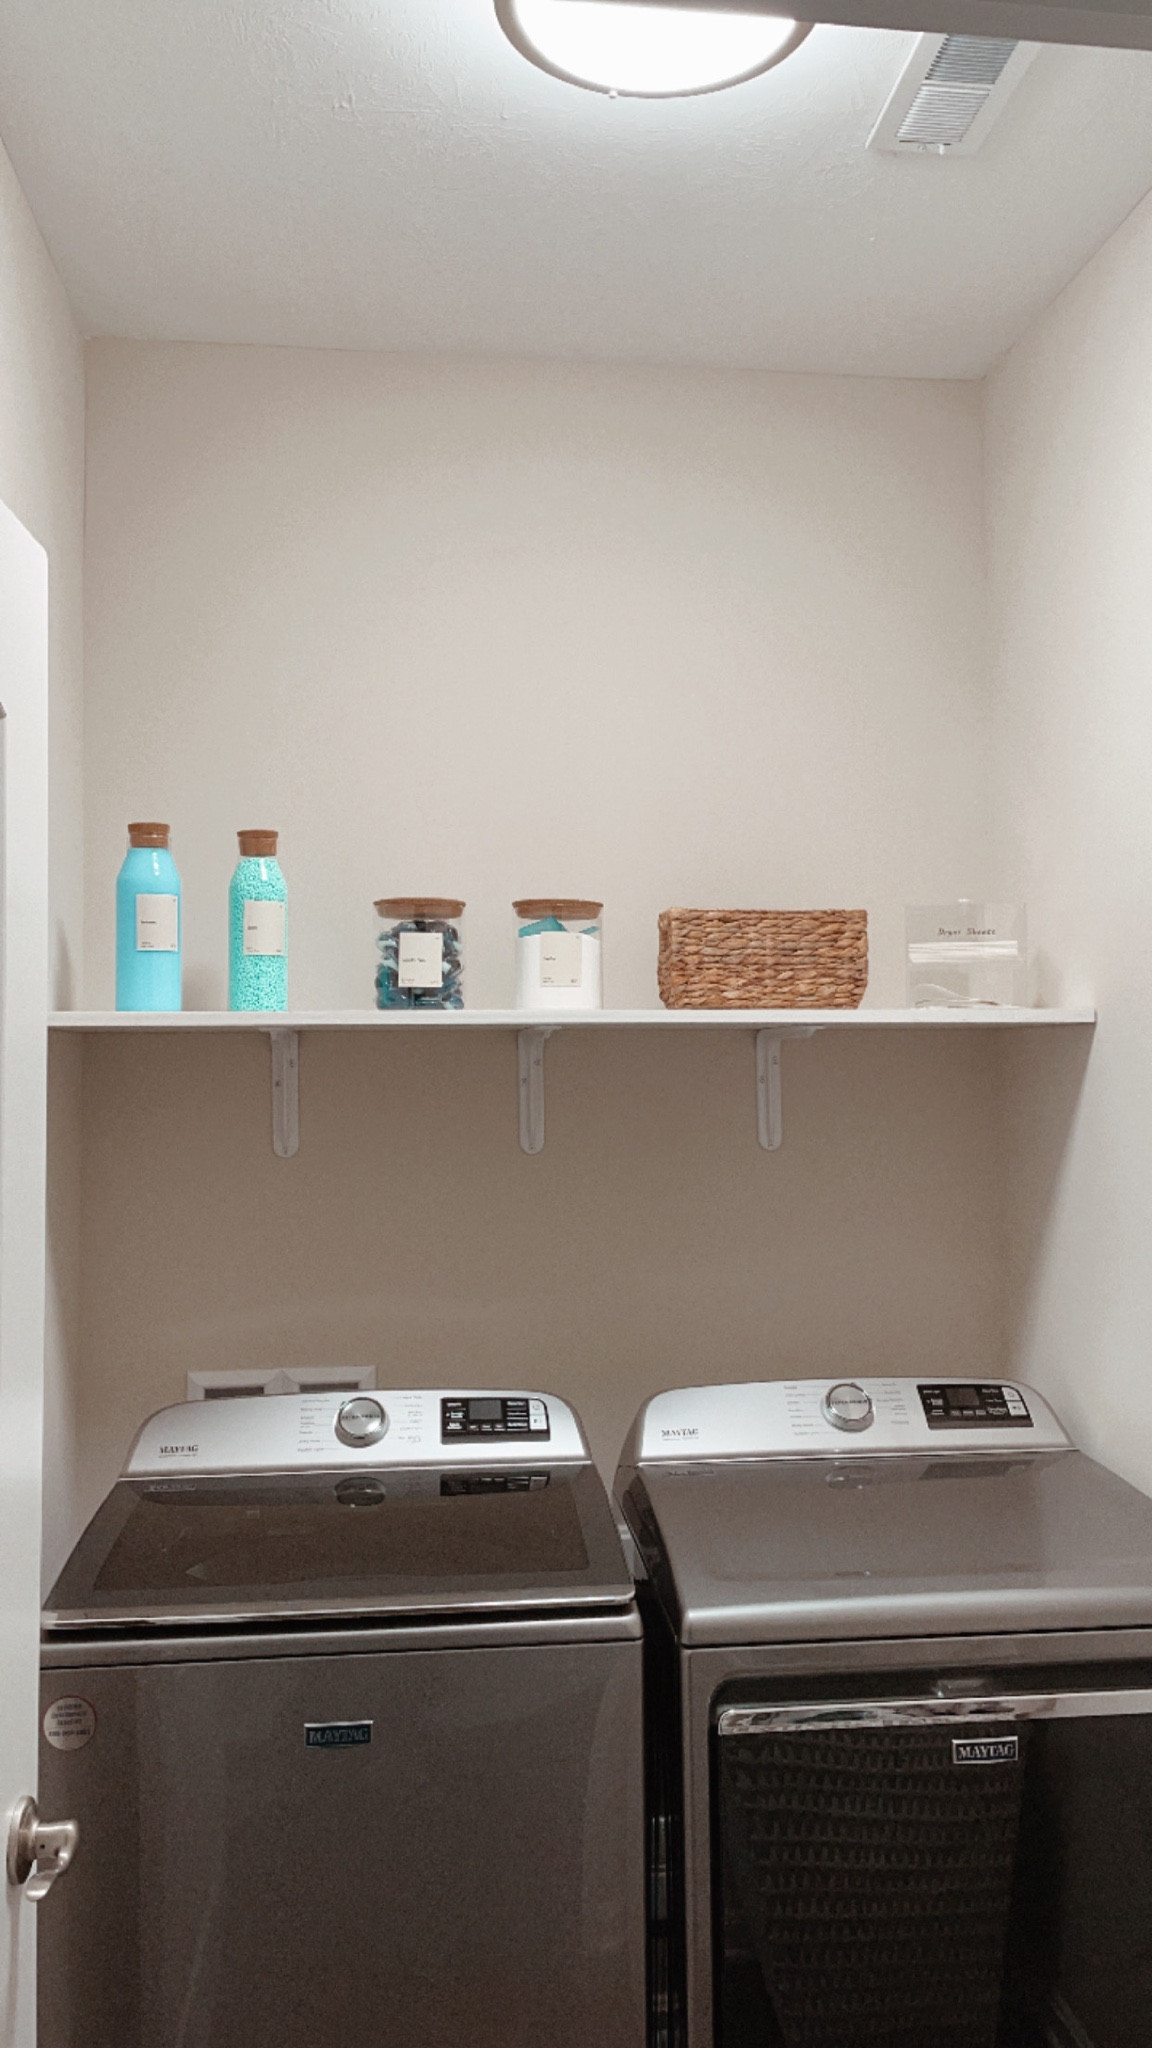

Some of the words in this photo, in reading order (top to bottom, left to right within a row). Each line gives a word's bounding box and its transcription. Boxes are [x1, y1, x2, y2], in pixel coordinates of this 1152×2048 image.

[159, 1444, 199, 1454] MAYTAG
[308, 1727, 370, 1744] MAYTAG
[958, 1744, 1015, 1759] MAYTAG
